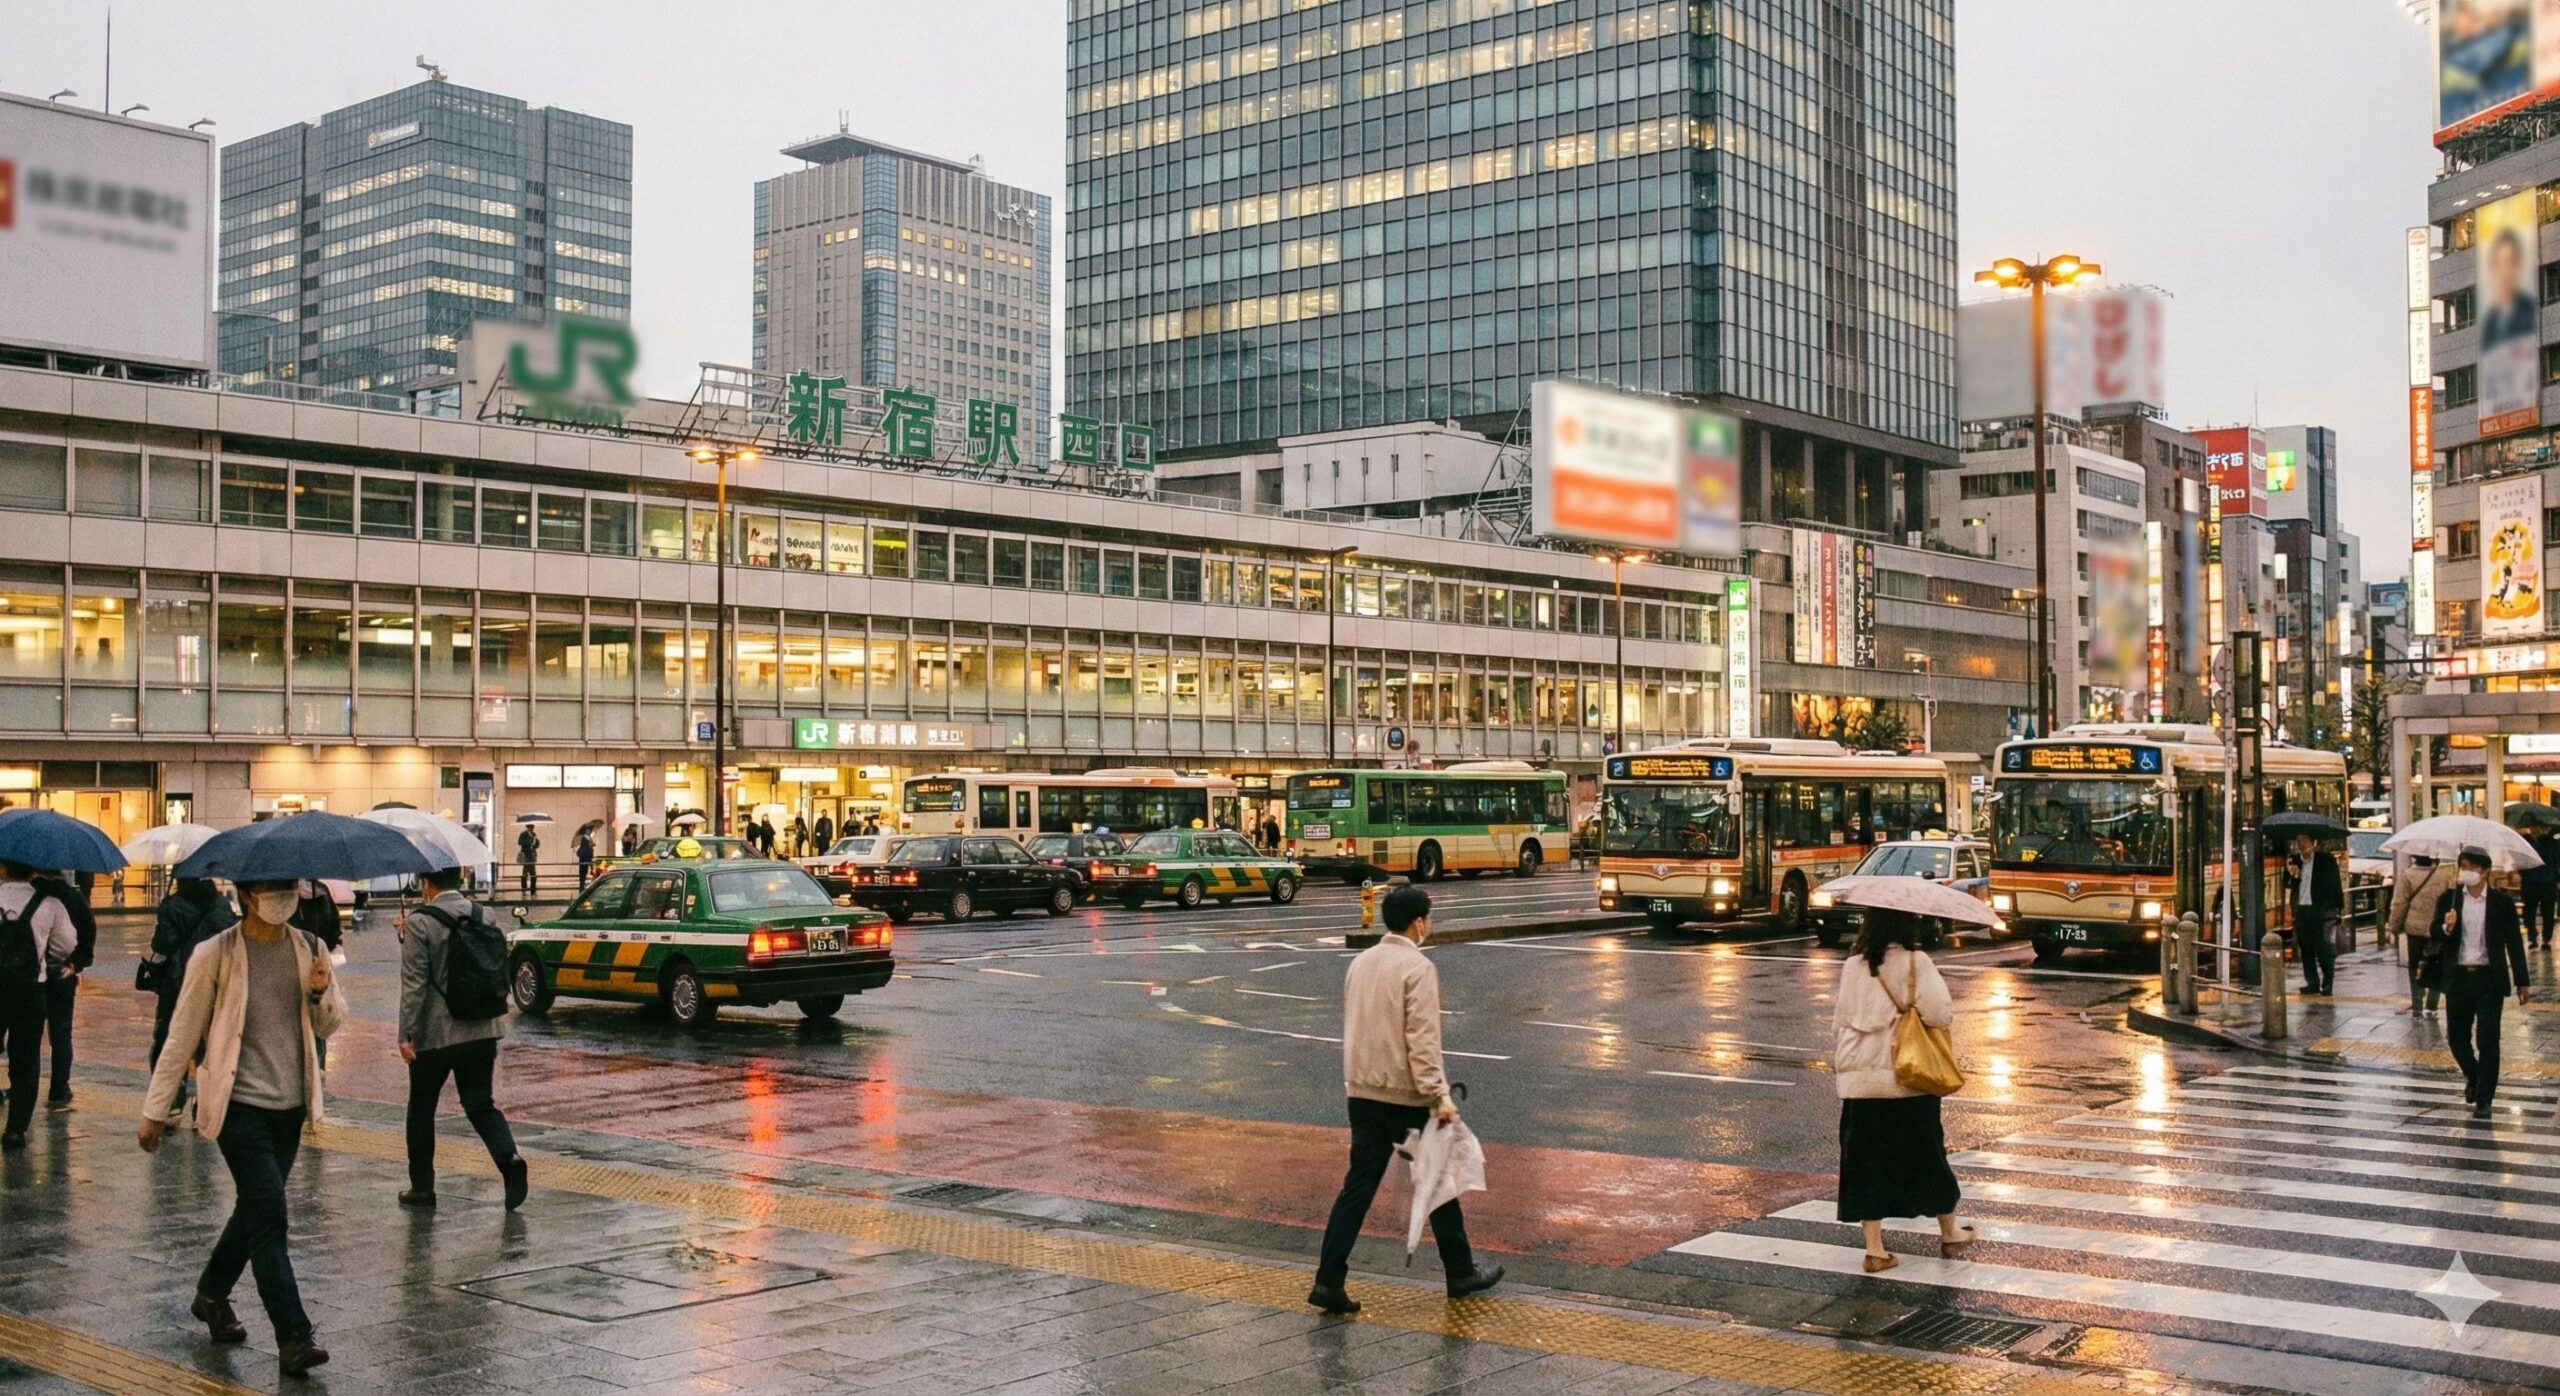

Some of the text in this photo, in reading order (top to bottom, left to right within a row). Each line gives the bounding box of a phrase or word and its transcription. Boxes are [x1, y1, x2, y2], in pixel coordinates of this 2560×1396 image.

[786, 368, 1155, 473] 新宿駅西口
[802, 722, 829, 743] JR
